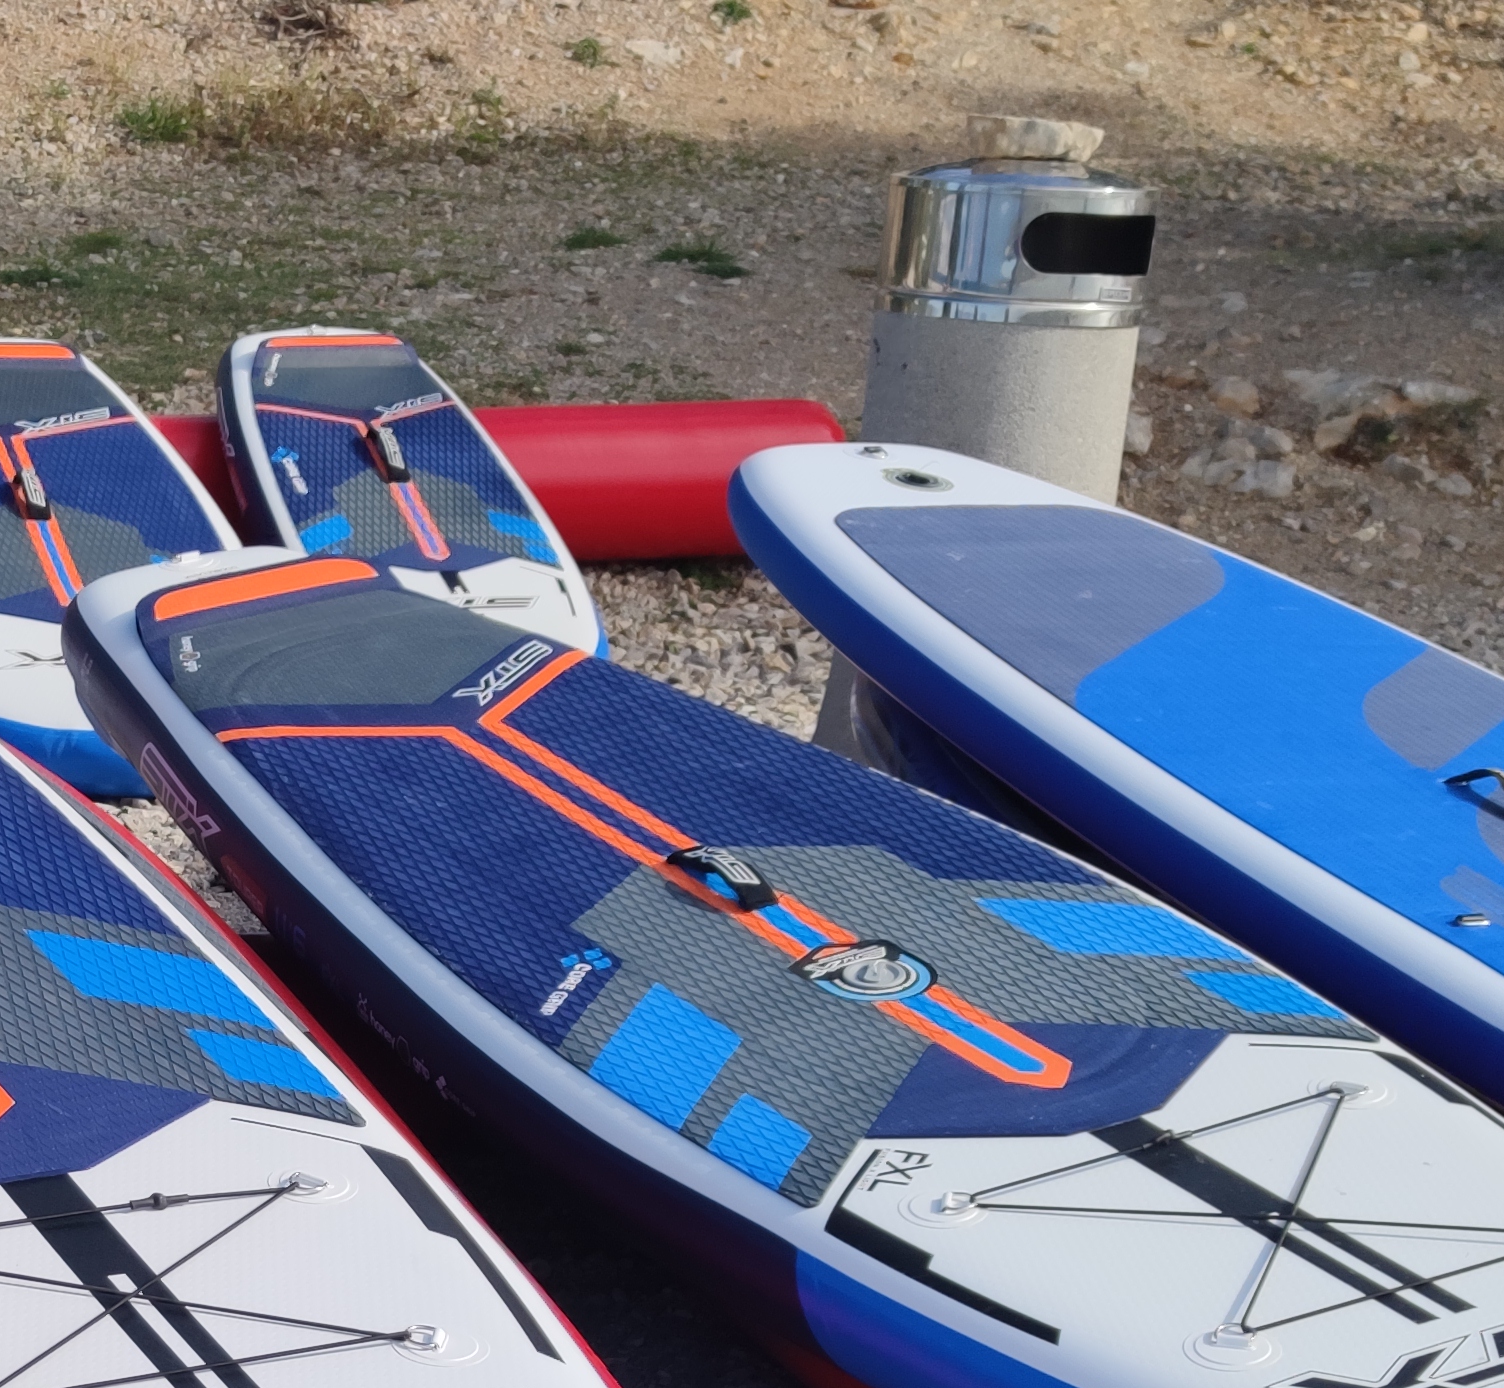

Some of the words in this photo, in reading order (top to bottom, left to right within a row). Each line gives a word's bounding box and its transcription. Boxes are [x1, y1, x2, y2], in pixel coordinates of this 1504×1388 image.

[12, 405, 111, 435] STX
[374, 392, 444, 419] STX
[452, 639, 552, 707] STX
[682, 845, 761, 885] STX
[867, 1149, 934, 1192] FXL
